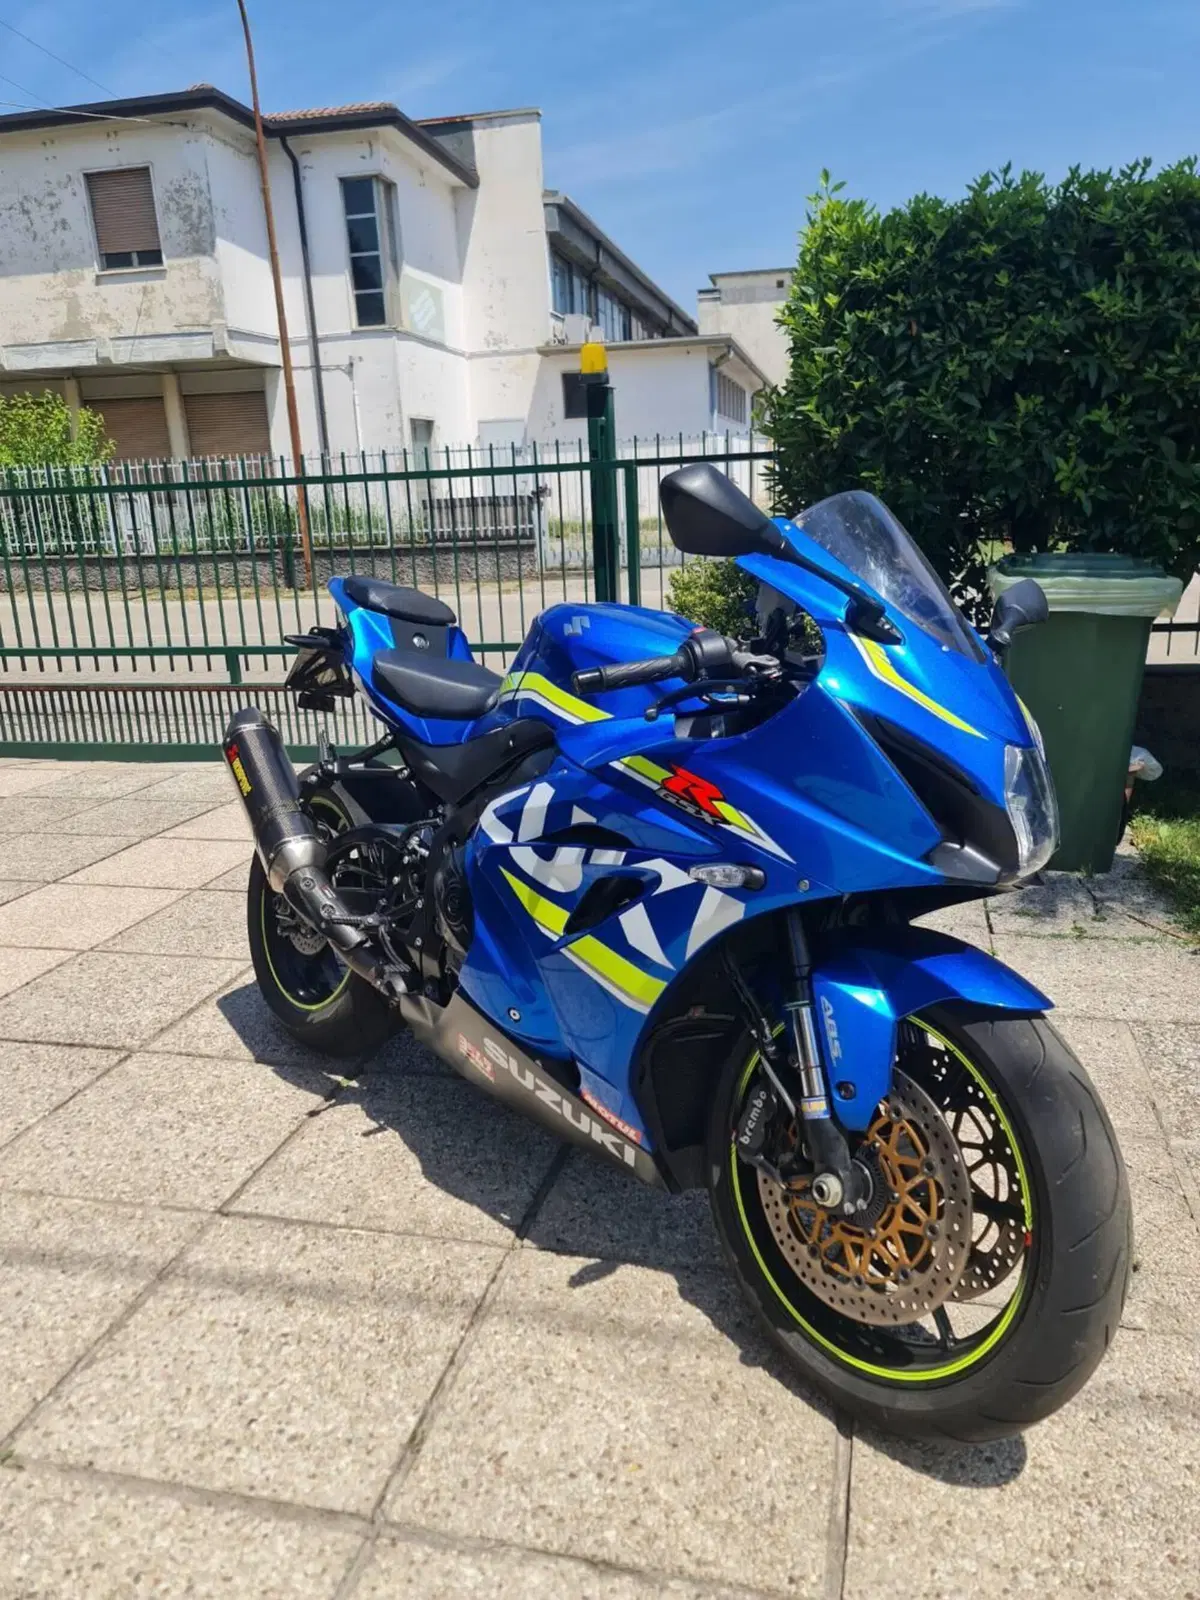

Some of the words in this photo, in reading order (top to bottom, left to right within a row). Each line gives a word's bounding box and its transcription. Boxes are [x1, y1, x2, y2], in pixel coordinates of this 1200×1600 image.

[820, 995, 842, 1067] ABS
[483, 1037, 636, 1168] SUZUKI
[739, 1090, 767, 1145] brembo
